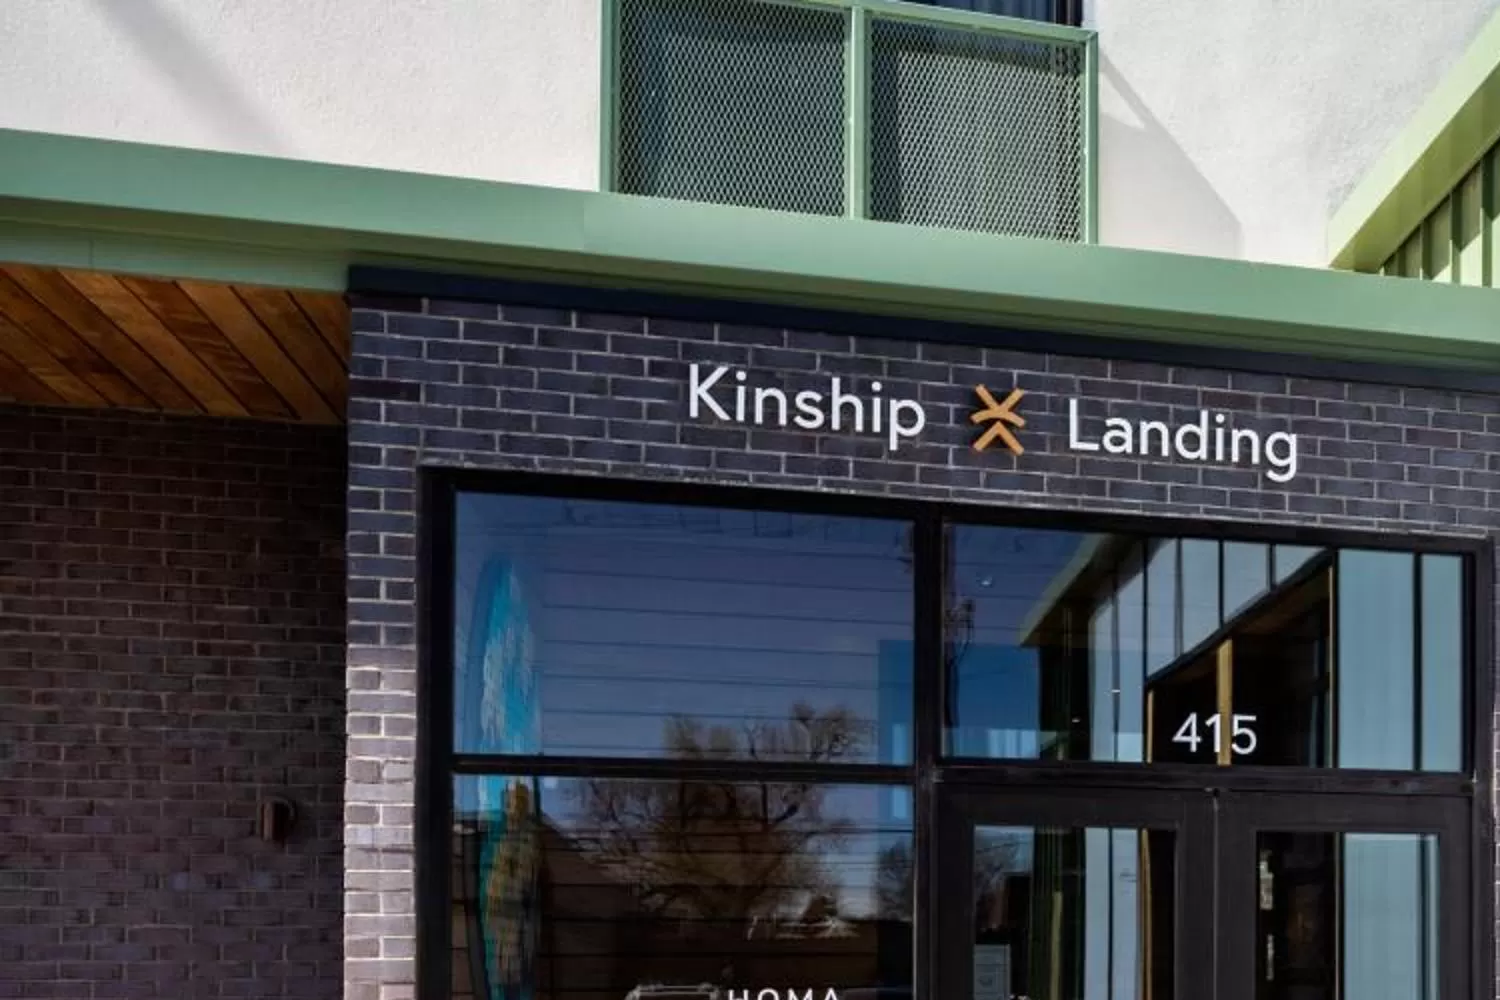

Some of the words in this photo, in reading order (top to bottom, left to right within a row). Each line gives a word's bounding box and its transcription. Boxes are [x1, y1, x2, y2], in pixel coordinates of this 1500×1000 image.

[688, 363, 926, 452] Kinship
[1068, 399, 1299, 483] Landing
[1172, 711, 1258, 755] 415
